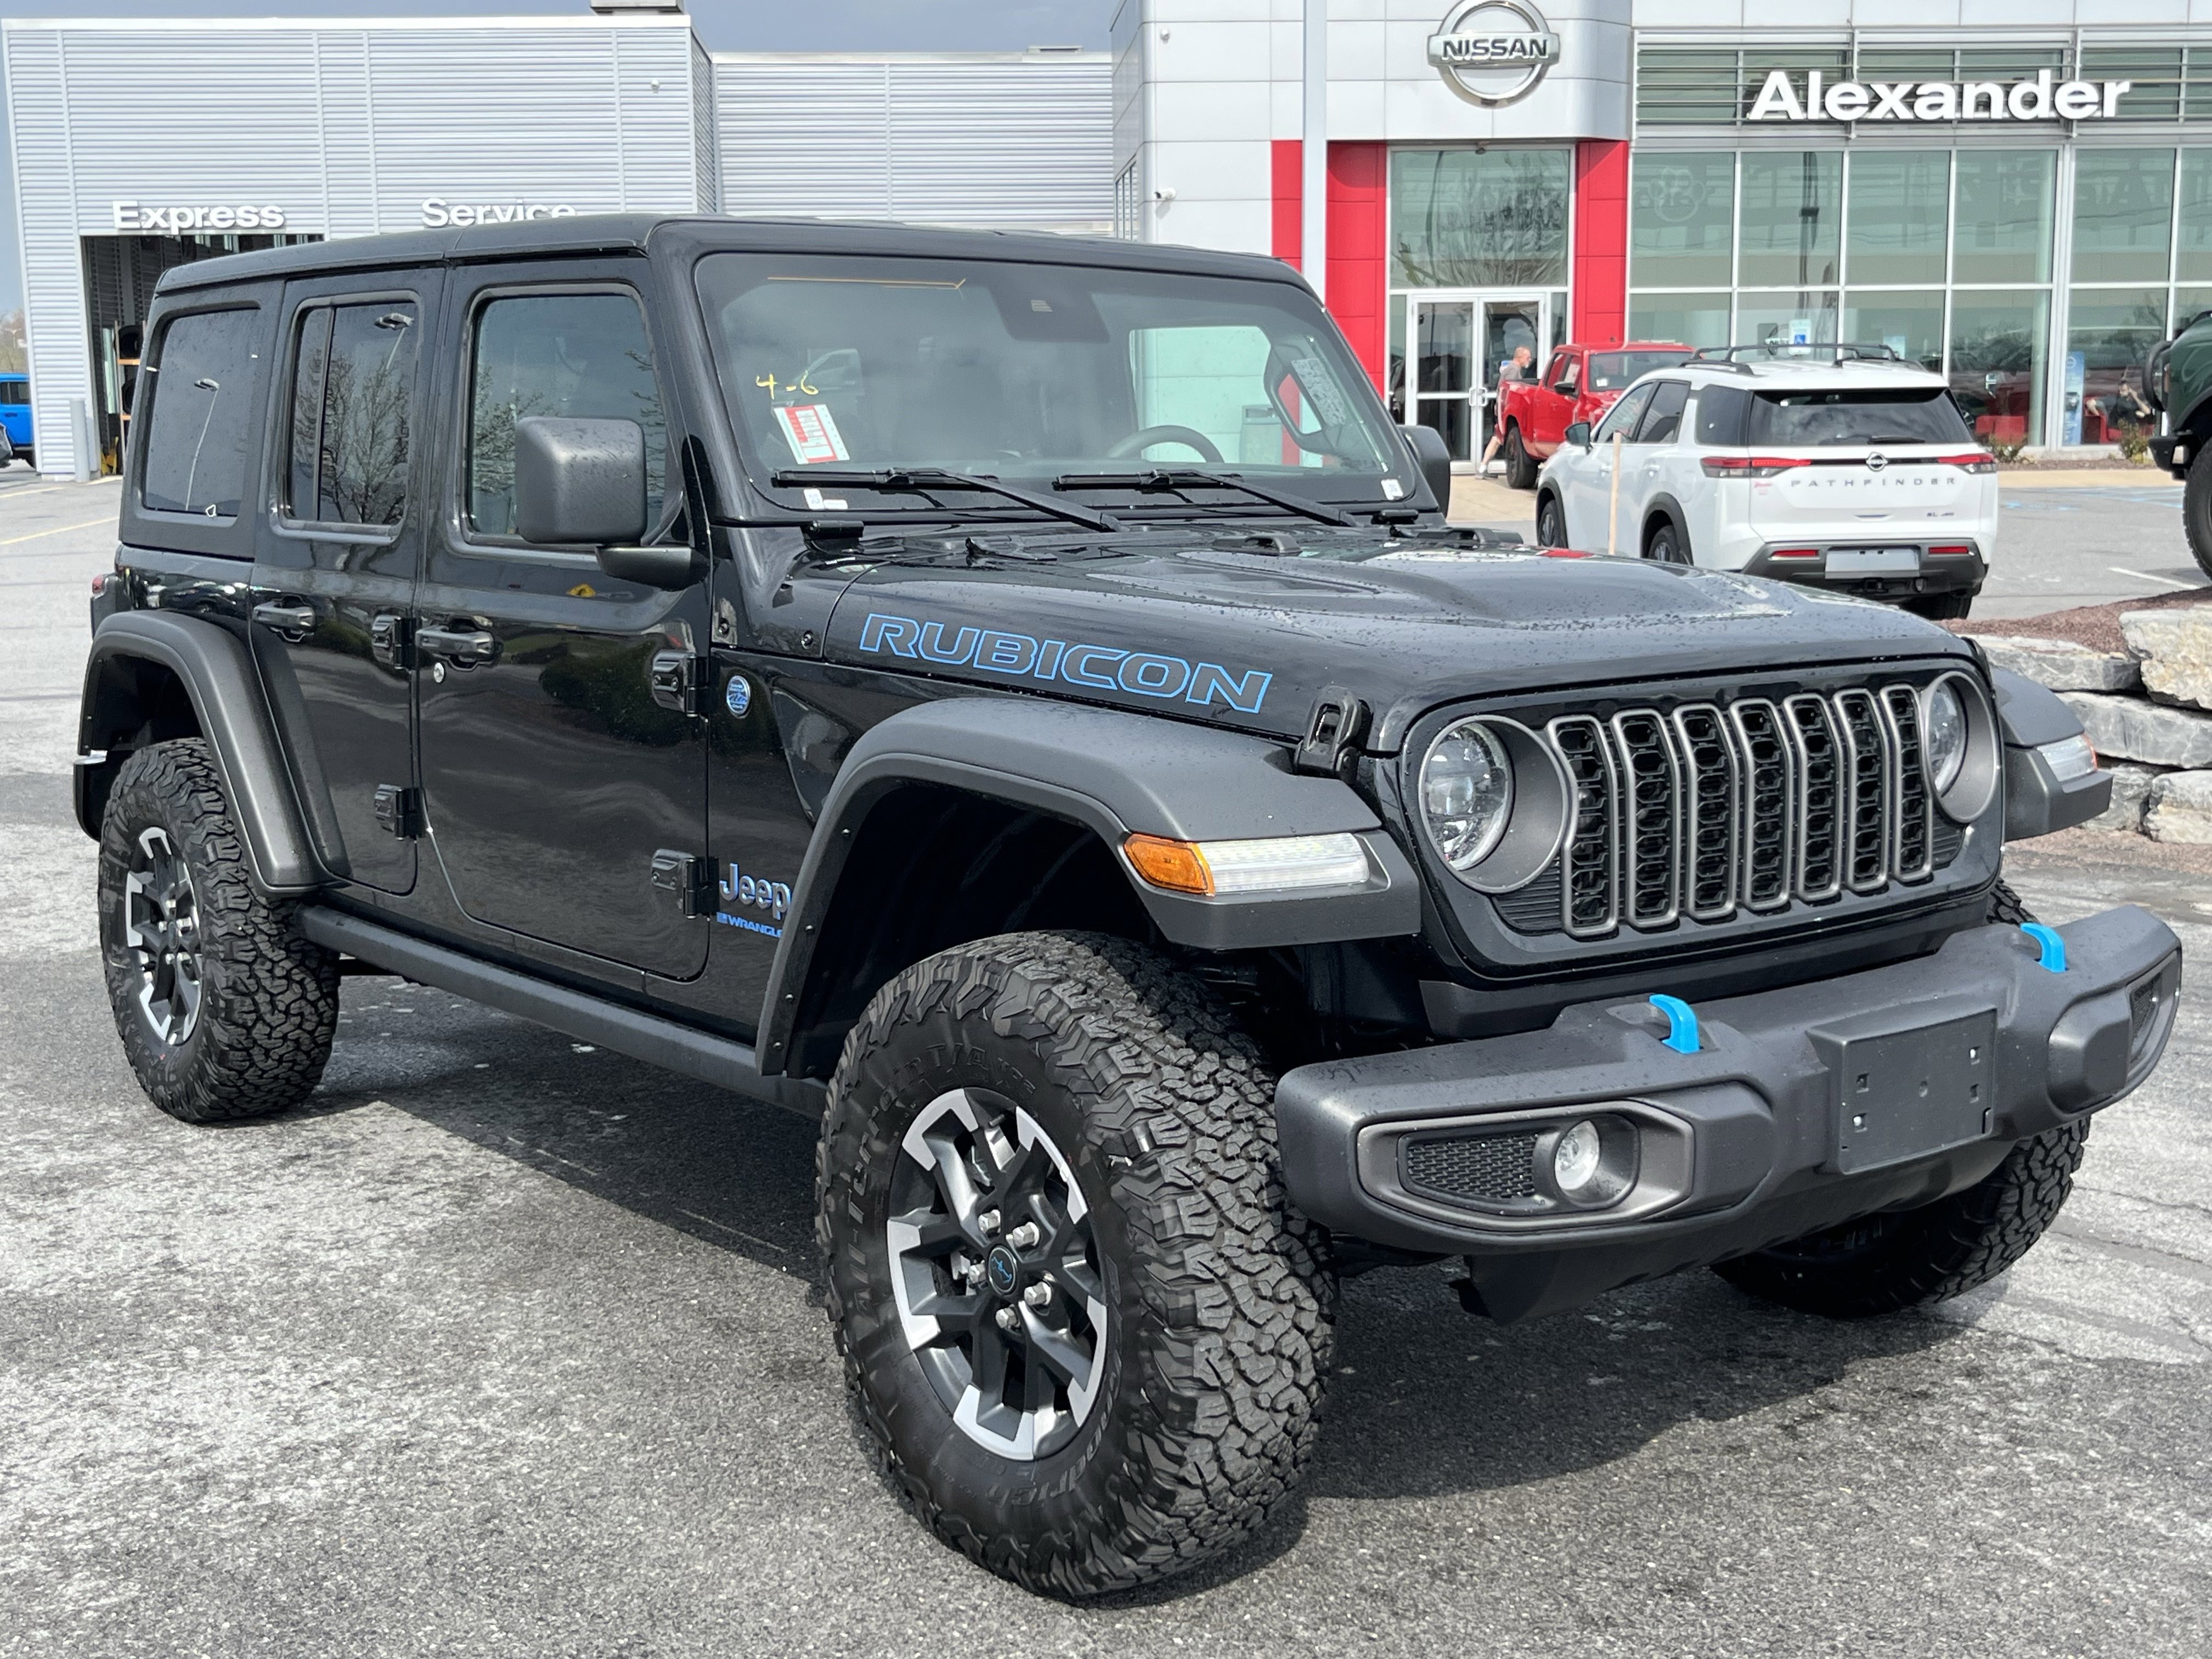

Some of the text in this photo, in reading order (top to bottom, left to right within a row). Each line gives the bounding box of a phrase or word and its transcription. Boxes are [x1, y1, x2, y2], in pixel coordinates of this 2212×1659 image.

[1441, 38, 1549, 60] NISSAN
[1747, 69, 2131, 121] Alexander
[112, 201, 285, 235] Express
[421, 198, 576, 228] Service
[1791, 477, 1955, 488] PATHFINDER
[859, 612, 1273, 713] RUBICON
[719, 862, 792, 921] Jeep
[727, 913, 783, 939] WRANGLE
